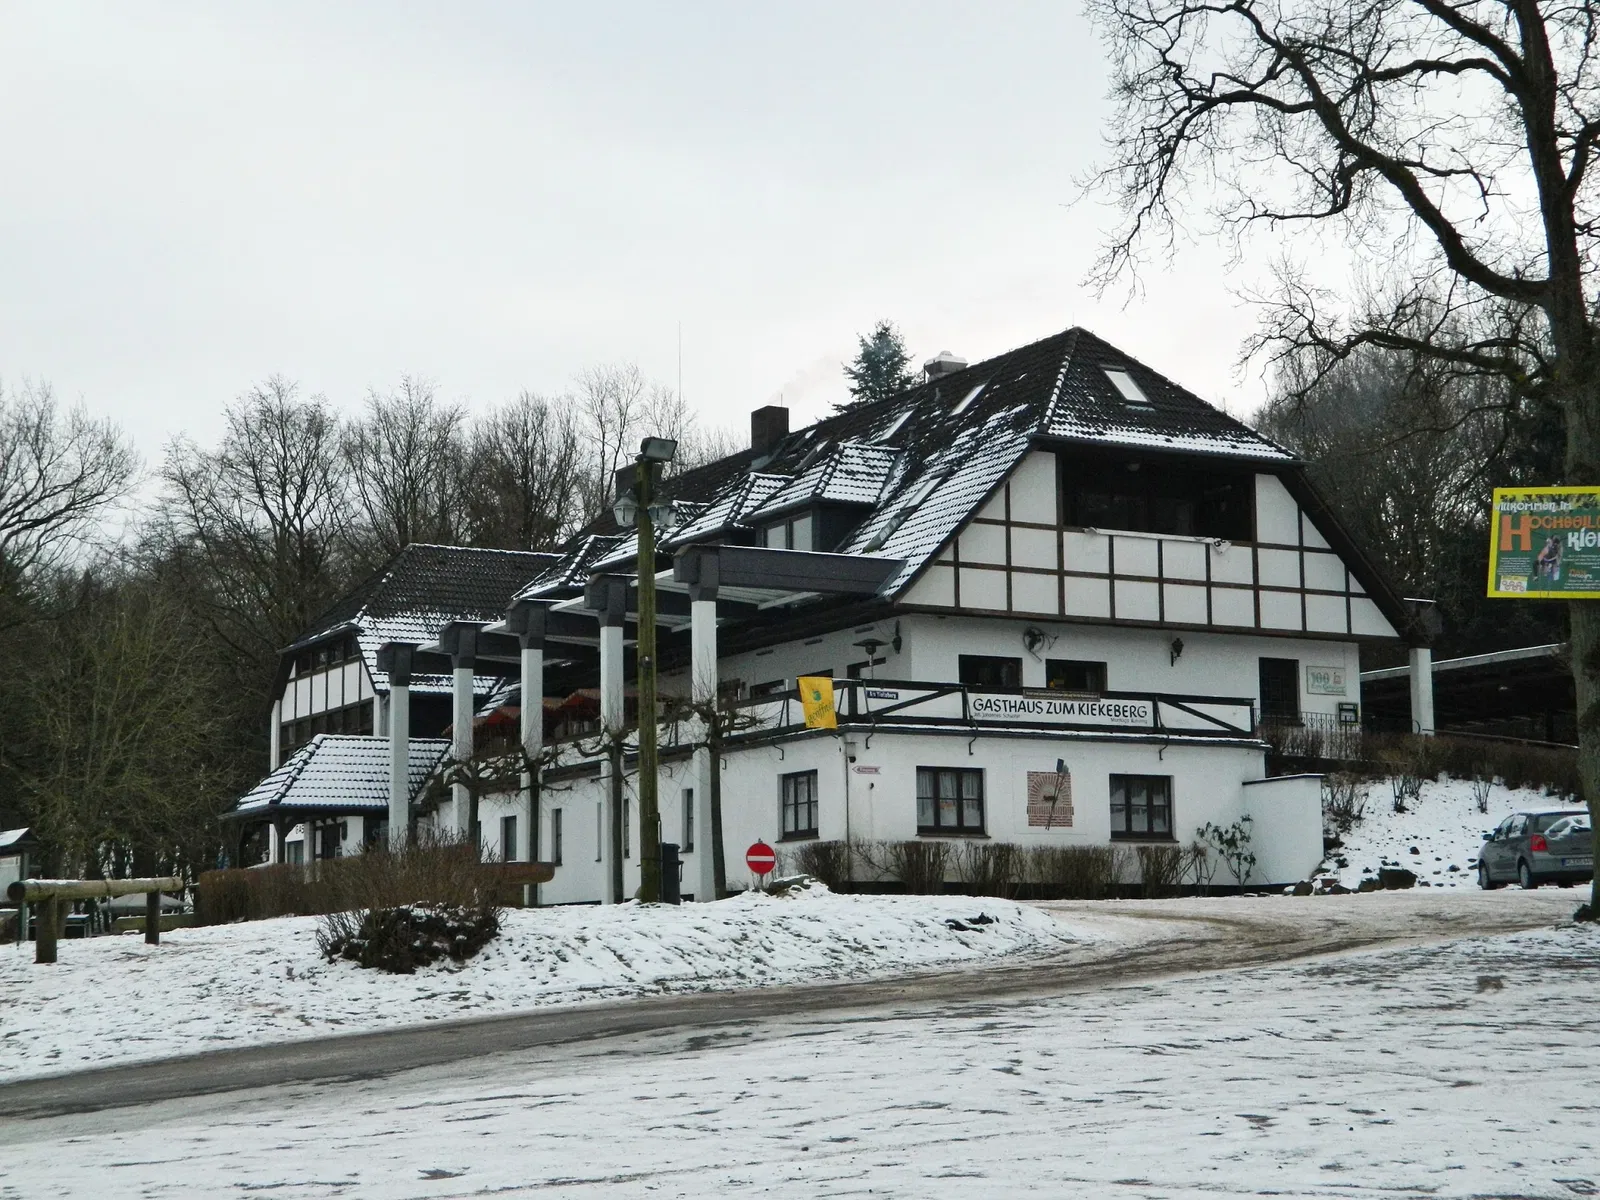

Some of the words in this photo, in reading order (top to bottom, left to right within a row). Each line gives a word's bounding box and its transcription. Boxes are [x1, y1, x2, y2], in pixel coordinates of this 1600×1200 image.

[973, 698, 1043, 714] GASTHAUS
[1046, 701, 1075, 715] ZUM
[1078, 703, 1147, 718] KIEKEBERG
